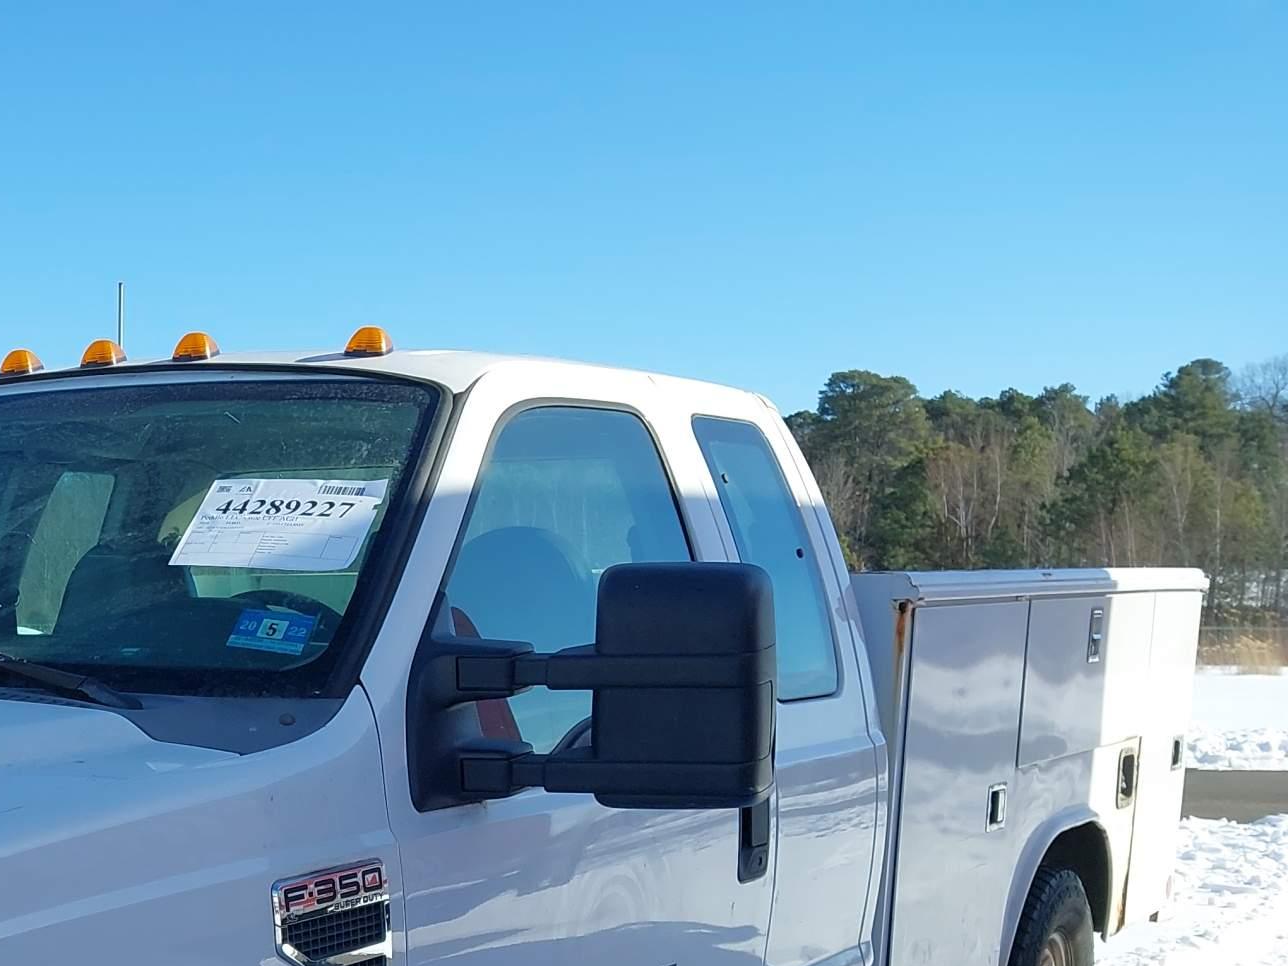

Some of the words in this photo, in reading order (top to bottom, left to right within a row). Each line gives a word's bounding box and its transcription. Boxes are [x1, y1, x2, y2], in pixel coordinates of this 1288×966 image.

[215, 498, 357, 519] 44289227
[239, 620, 258, 631] 20
[265, 622, 278, 637] 5
[288, 626, 307, 638] 22
[283, 866, 383, 913] F-350
[333, 897, 362, 912] SUPER
[362, 891, 385, 904] DUTY
